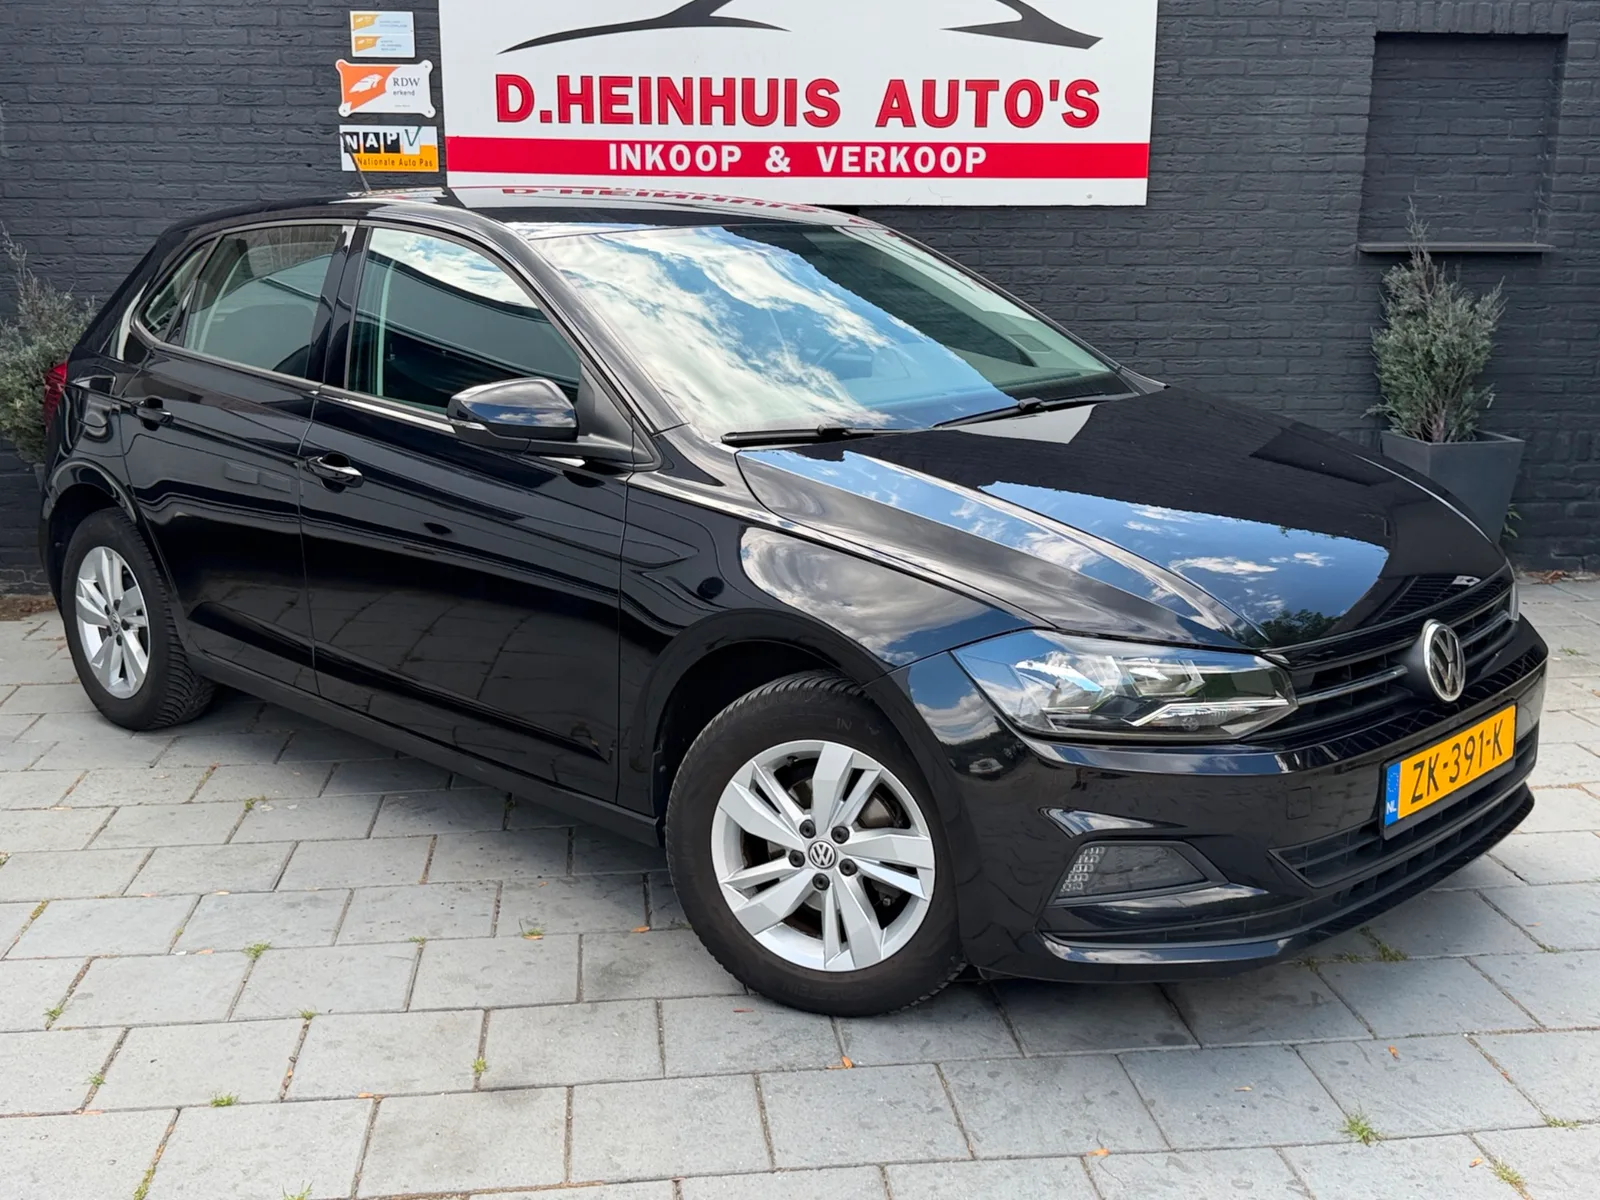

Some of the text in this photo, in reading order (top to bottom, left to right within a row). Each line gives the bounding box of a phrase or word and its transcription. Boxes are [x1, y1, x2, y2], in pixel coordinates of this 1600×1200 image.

[392, 77, 421, 87] RDW
[393, 89, 416, 97] erkend
[496, 74, 1100, 129] D.HEINHUIS AUTO'S
[357, 156, 433, 168] Nationale Auto Pas
[609, 143, 988, 174] INKOOP & VERKOOP
[1410, 718, 1503, 805] ZK-391-K
[1386, 799, 1397, 814] NL
